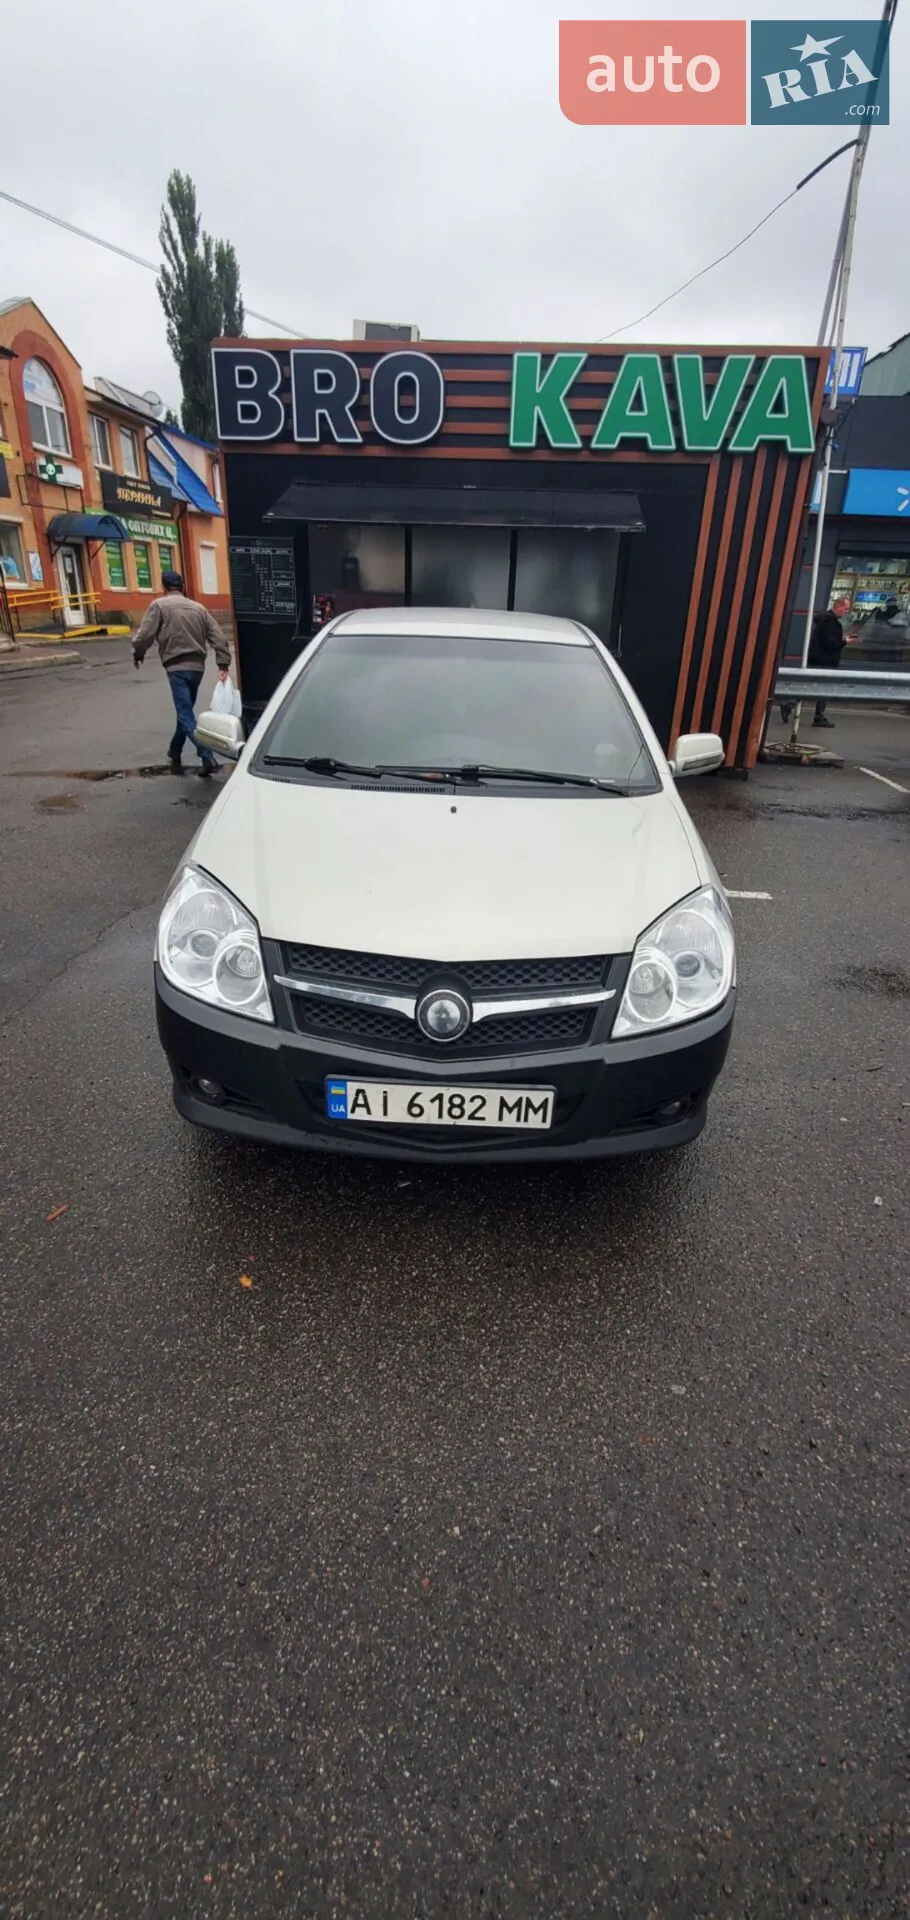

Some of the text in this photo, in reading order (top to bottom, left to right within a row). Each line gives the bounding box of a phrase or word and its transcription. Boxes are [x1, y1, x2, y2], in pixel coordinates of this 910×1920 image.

[211, 347, 816, 453] BRO KAVA
[331, 1104, 346, 1113] UA
[407, 1091, 488, 1121] 6182
[498, 1095, 549, 1123] MM
